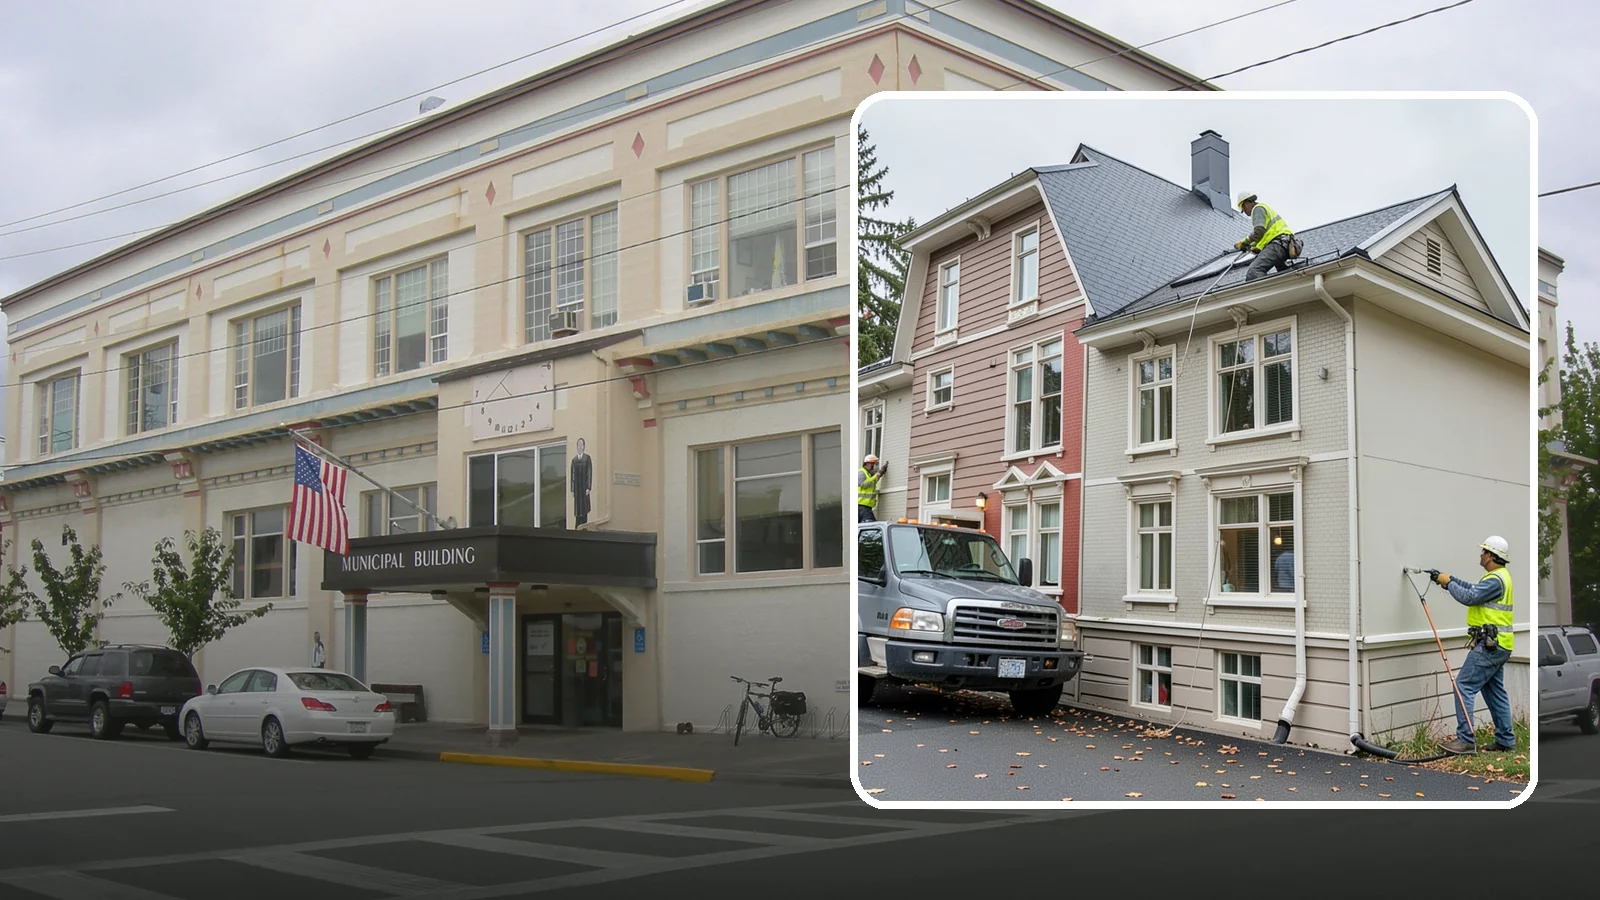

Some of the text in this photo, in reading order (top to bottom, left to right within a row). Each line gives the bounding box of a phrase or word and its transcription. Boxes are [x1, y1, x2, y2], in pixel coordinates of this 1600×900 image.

[480, 407, 485, 415] 8
[528, 414, 533, 422] 3
[521, 420, 525, 428] 2
[507, 425, 513, 433] 12
[342, 547, 475, 572] MUNICIPAL BUILDING
